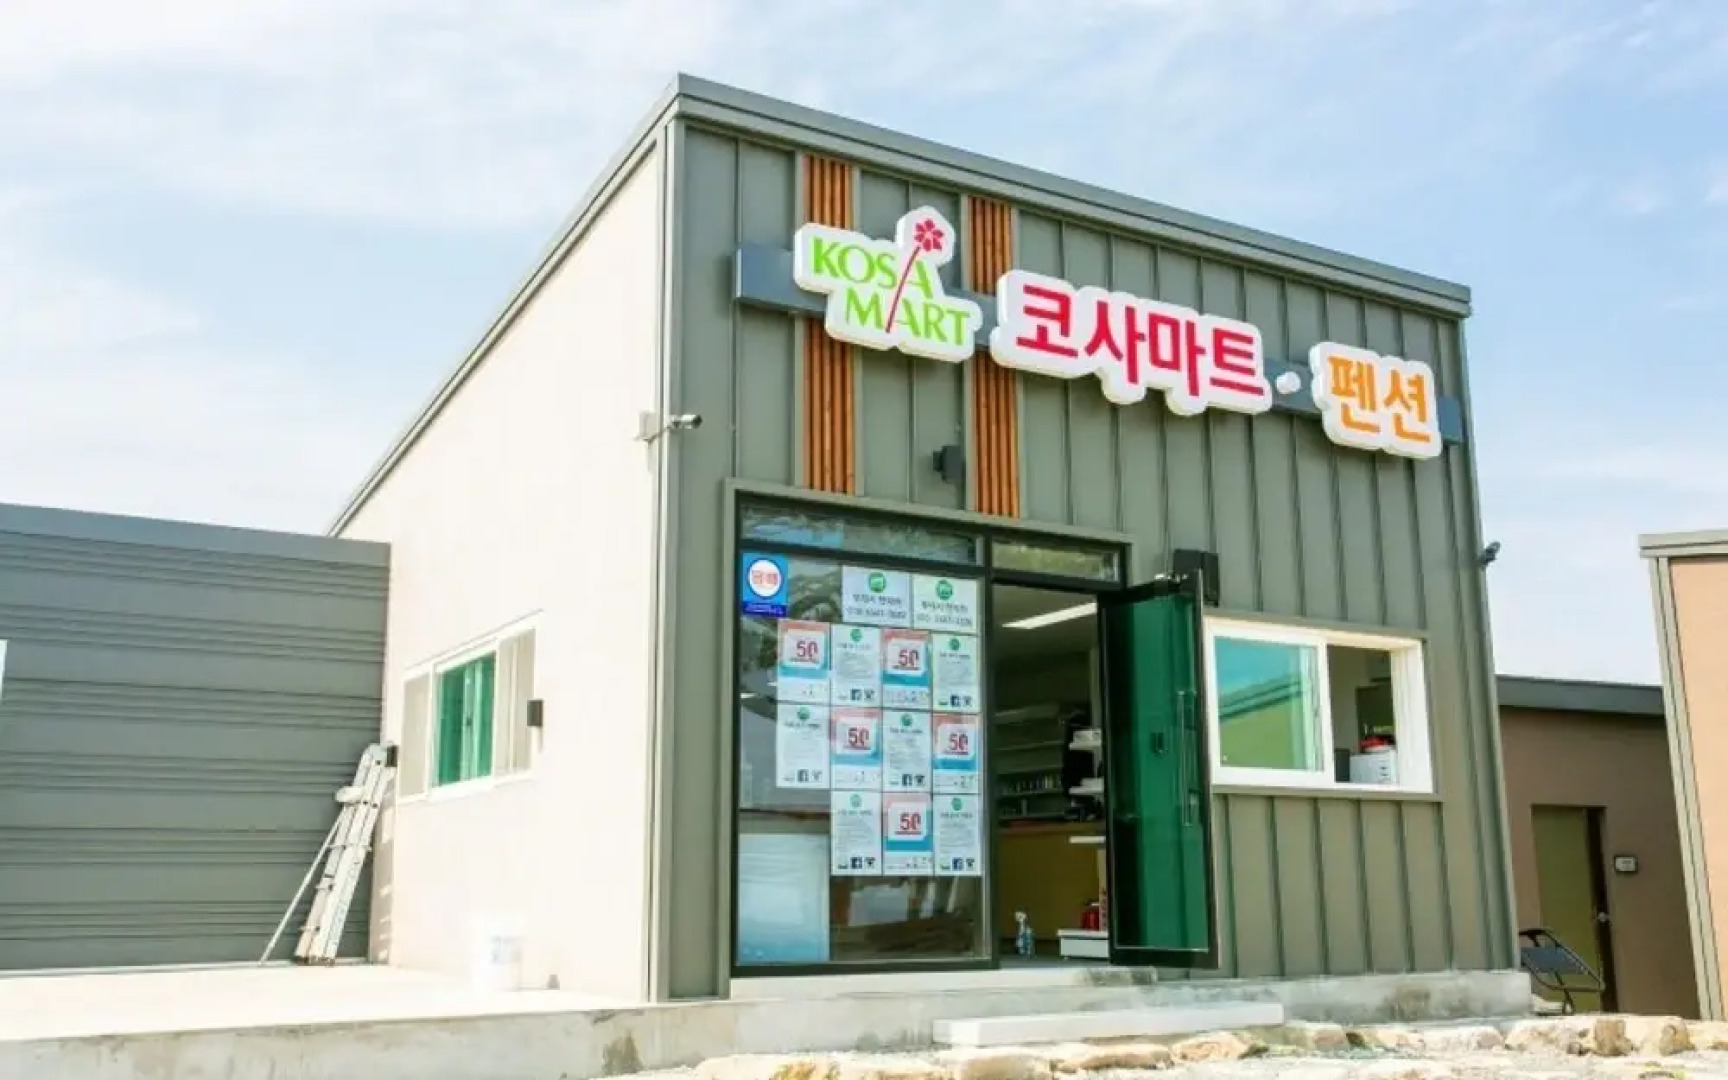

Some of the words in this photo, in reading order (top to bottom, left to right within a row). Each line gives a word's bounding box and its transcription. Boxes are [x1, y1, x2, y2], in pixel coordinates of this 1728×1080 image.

[812, 236, 934, 299] KOSA
[845, 287, 970, 346] MART
[1016, 284, 1265, 397] 코사마트
[1327, 356, 1431, 443] 펜션
